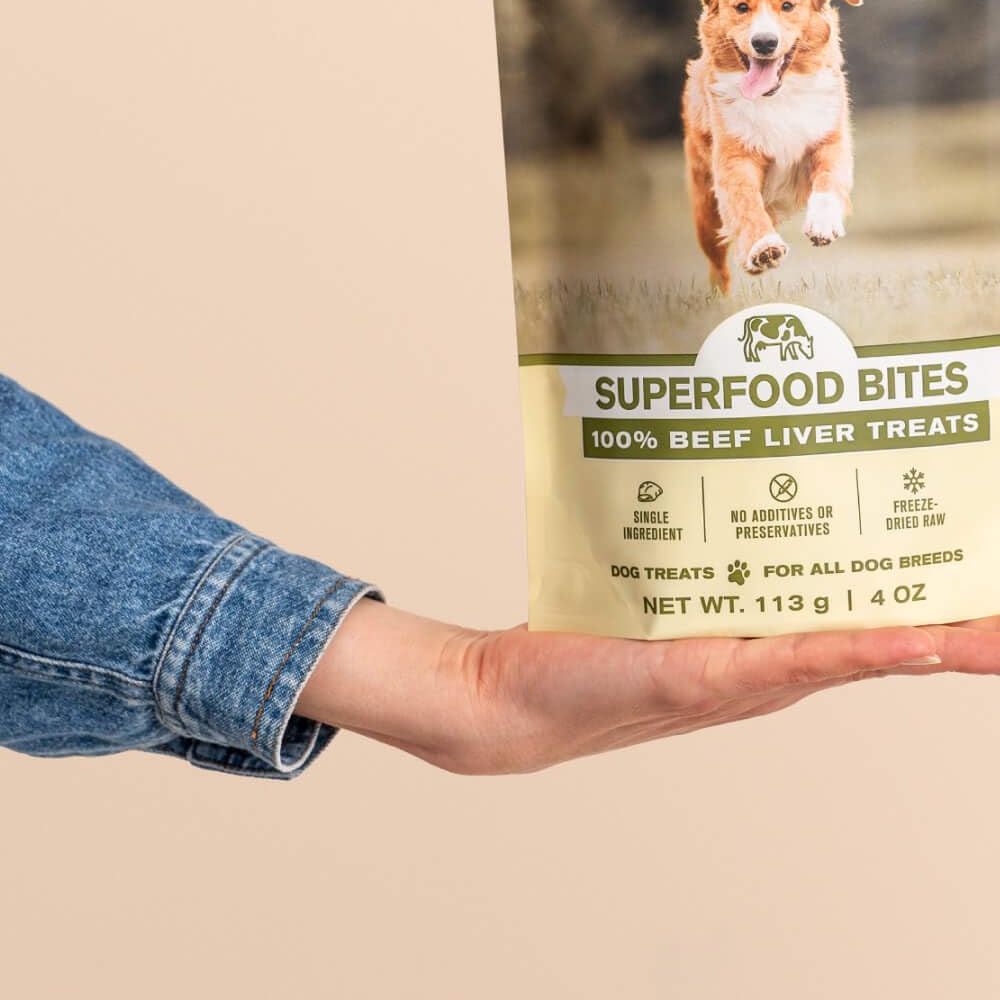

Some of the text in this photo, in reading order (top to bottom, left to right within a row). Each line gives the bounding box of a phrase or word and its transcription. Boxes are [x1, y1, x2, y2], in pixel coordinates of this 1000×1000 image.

[594, 361, 969, 411] SUPERFOOD BITES
[591, 412, 980, 450] 100% BEEF LIVER TREATS
[730, 504, 834, 524] NO ADDITIVES OR
[893, 497, 939, 514] FREEZE-
[633, 510, 670, 525] SINGLE
[886, 512, 946, 531] DRIED RAW
[623, 526, 684, 542] INGREDIENT
[735, 522, 831, 540] PRESERVATIVES
[611, 548, 964, 581] DOG TREATS FOR ALL DOG BREEDS
[643, 583, 927, 615] NET WT. 113 g 4 OZ
